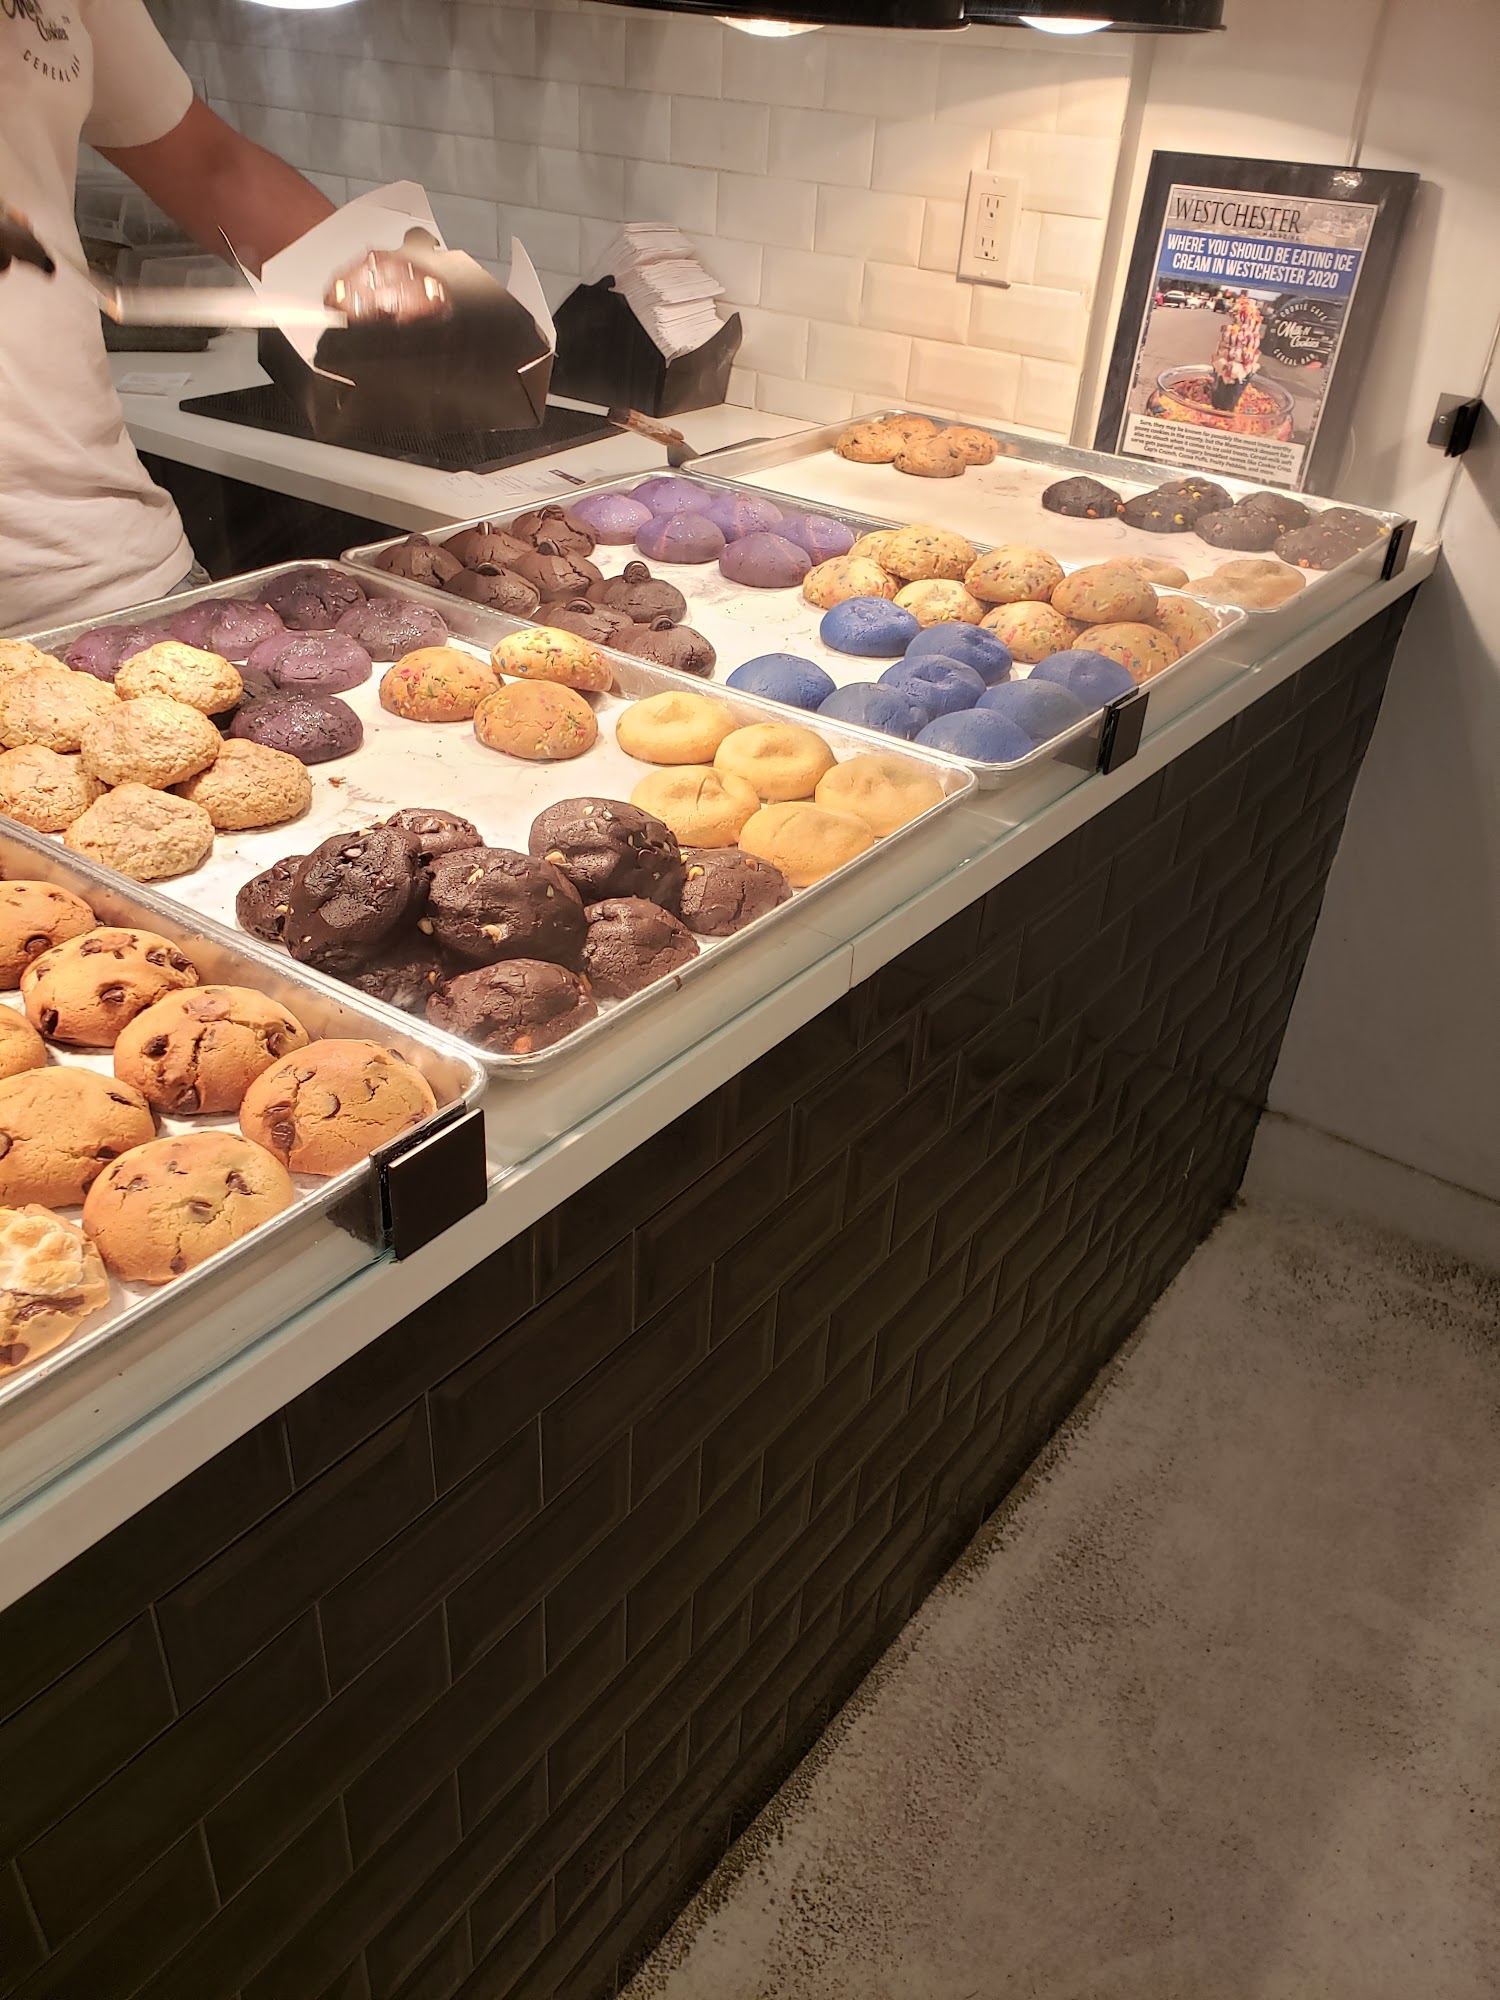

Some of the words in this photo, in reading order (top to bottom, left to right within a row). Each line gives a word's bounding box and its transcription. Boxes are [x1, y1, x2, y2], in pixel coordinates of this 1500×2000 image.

[23, 50, 71, 82] CEREAL
[1176, 198, 1301, 233] WESTCHESTER
[1168, 234, 1205, 253] WHERE
[1208, 238, 1229, 256] YOU
[1229, 242, 1274, 262] SHOULD
[1274, 246, 1292, 264] BE
[1292, 248, 1333, 270] EATING
[1334, 253, 1355, 272] ICE
[1173, 253, 1211, 272] CREAM
[1212, 258, 1225, 274] IN
[1226, 260, 1306, 284] WESTCHESTER
[1306, 270, 1339, 288] 2020
[1280, 304, 1308, 318] COOKIE
[1274, 348, 1297, 366] CEREAL
[1300, 354, 1316, 364] BAR
[1211, 432, 1232, 442] possibly
[1186, 448, 1202, 456] sugary
[1259, 448, 1280, 456] dessert
